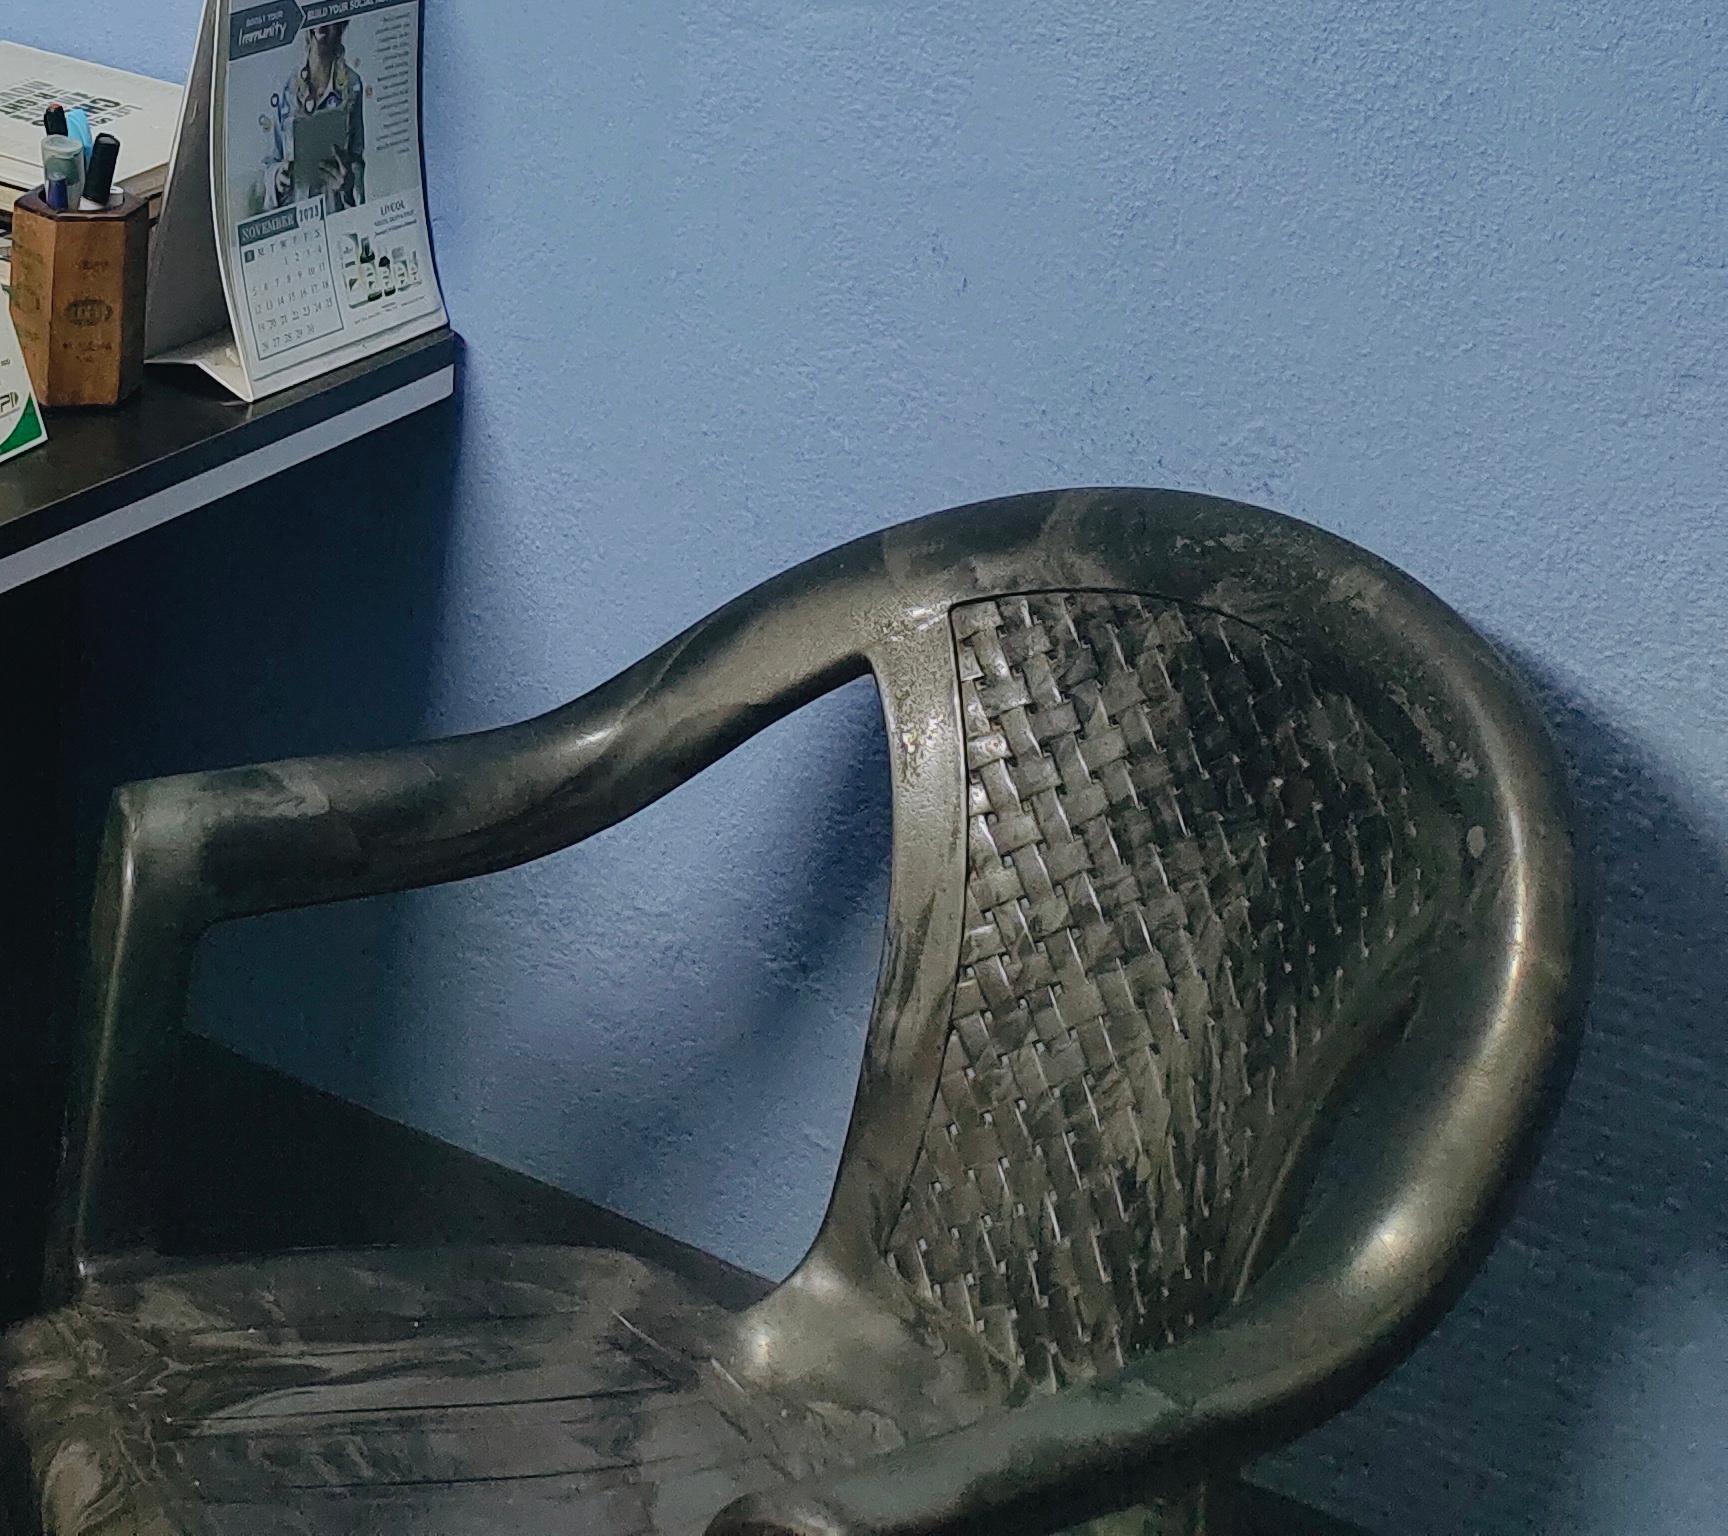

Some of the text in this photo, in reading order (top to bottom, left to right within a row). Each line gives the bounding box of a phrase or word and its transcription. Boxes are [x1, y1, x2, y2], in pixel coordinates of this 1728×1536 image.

[328, 3, 348, 16] YOUR
[238, 22, 286, 46] Immunity
[242, 214, 295, 241] NOVEMBER
